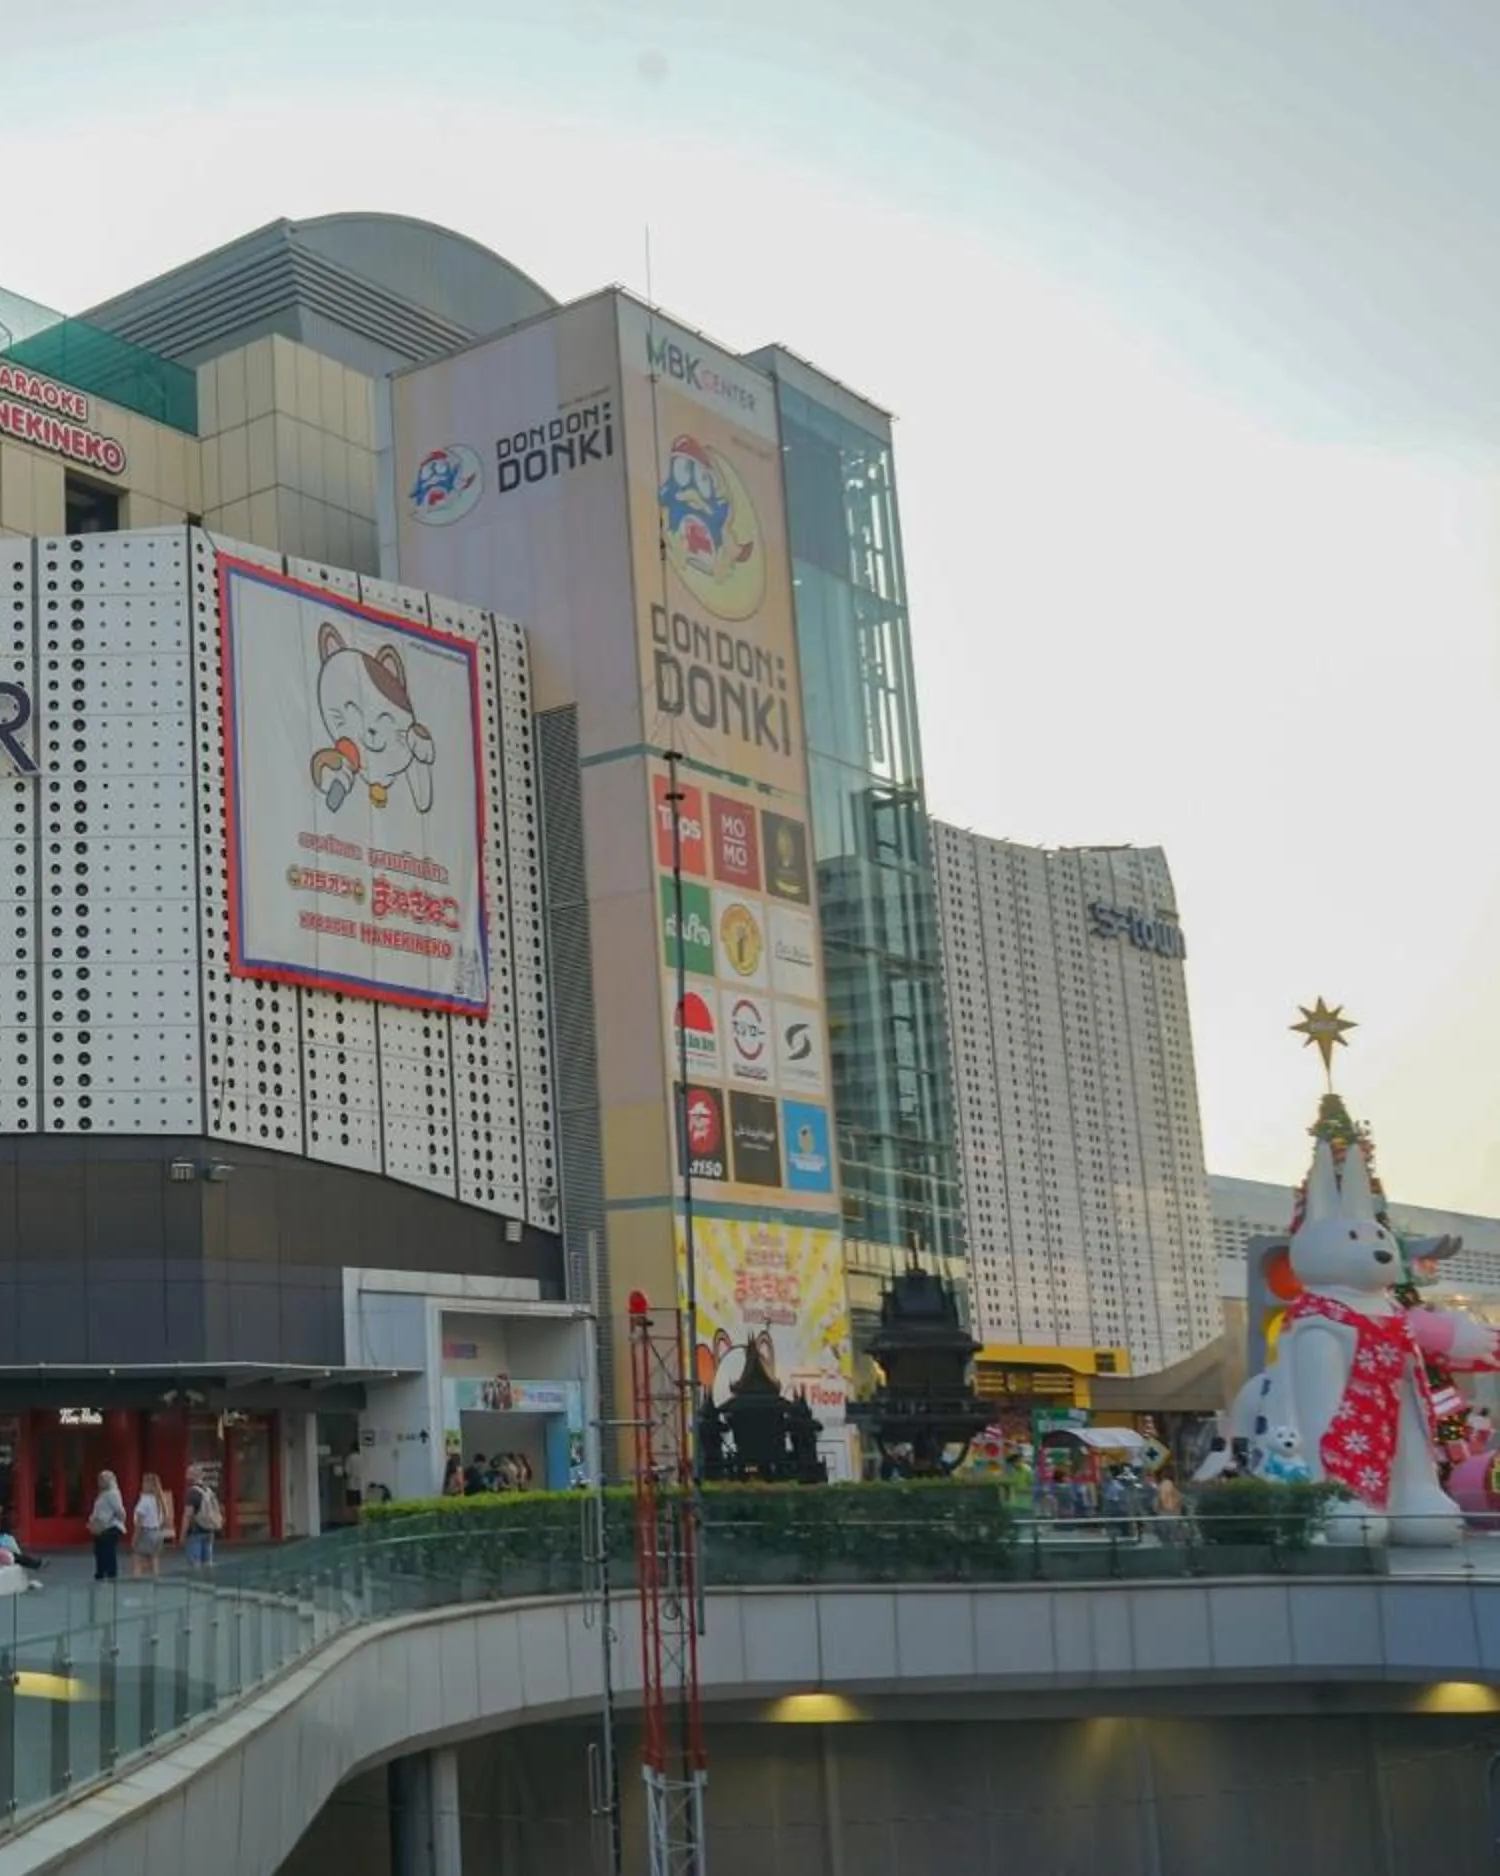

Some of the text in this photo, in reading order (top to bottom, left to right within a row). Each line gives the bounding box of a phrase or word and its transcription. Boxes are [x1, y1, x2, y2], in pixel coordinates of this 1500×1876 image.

[499, 424, 614, 493] DONKI
[654, 648, 792, 757] DONKI
[657, 803, 702, 843] Tps
[721, 814, 746, 838] MO
[723, 844, 748, 867] MO
